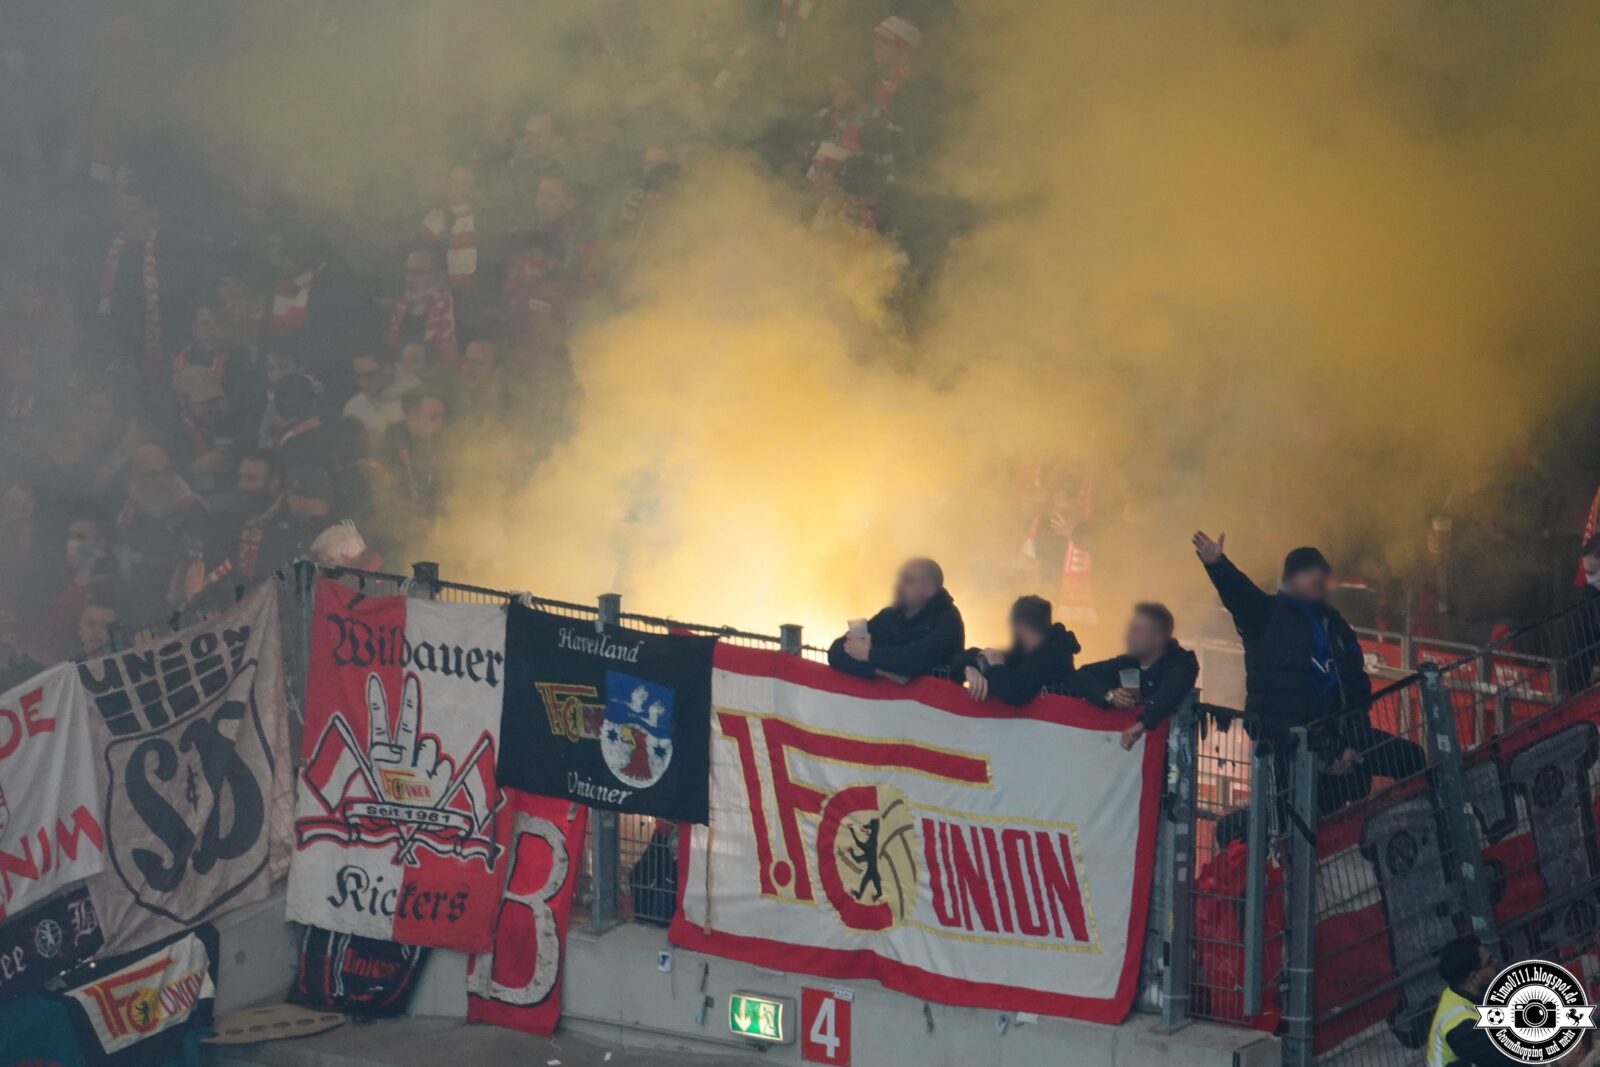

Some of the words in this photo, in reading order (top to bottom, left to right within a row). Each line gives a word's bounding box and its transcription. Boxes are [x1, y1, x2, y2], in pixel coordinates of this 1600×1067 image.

[326, 612, 504, 688] Wildauer
[366, 805, 400, 818] Seit
[326, 864, 468, 922] Kickers
[921, 816, 1090, 943] UNION
[810, 997, 840, 1058] 4
